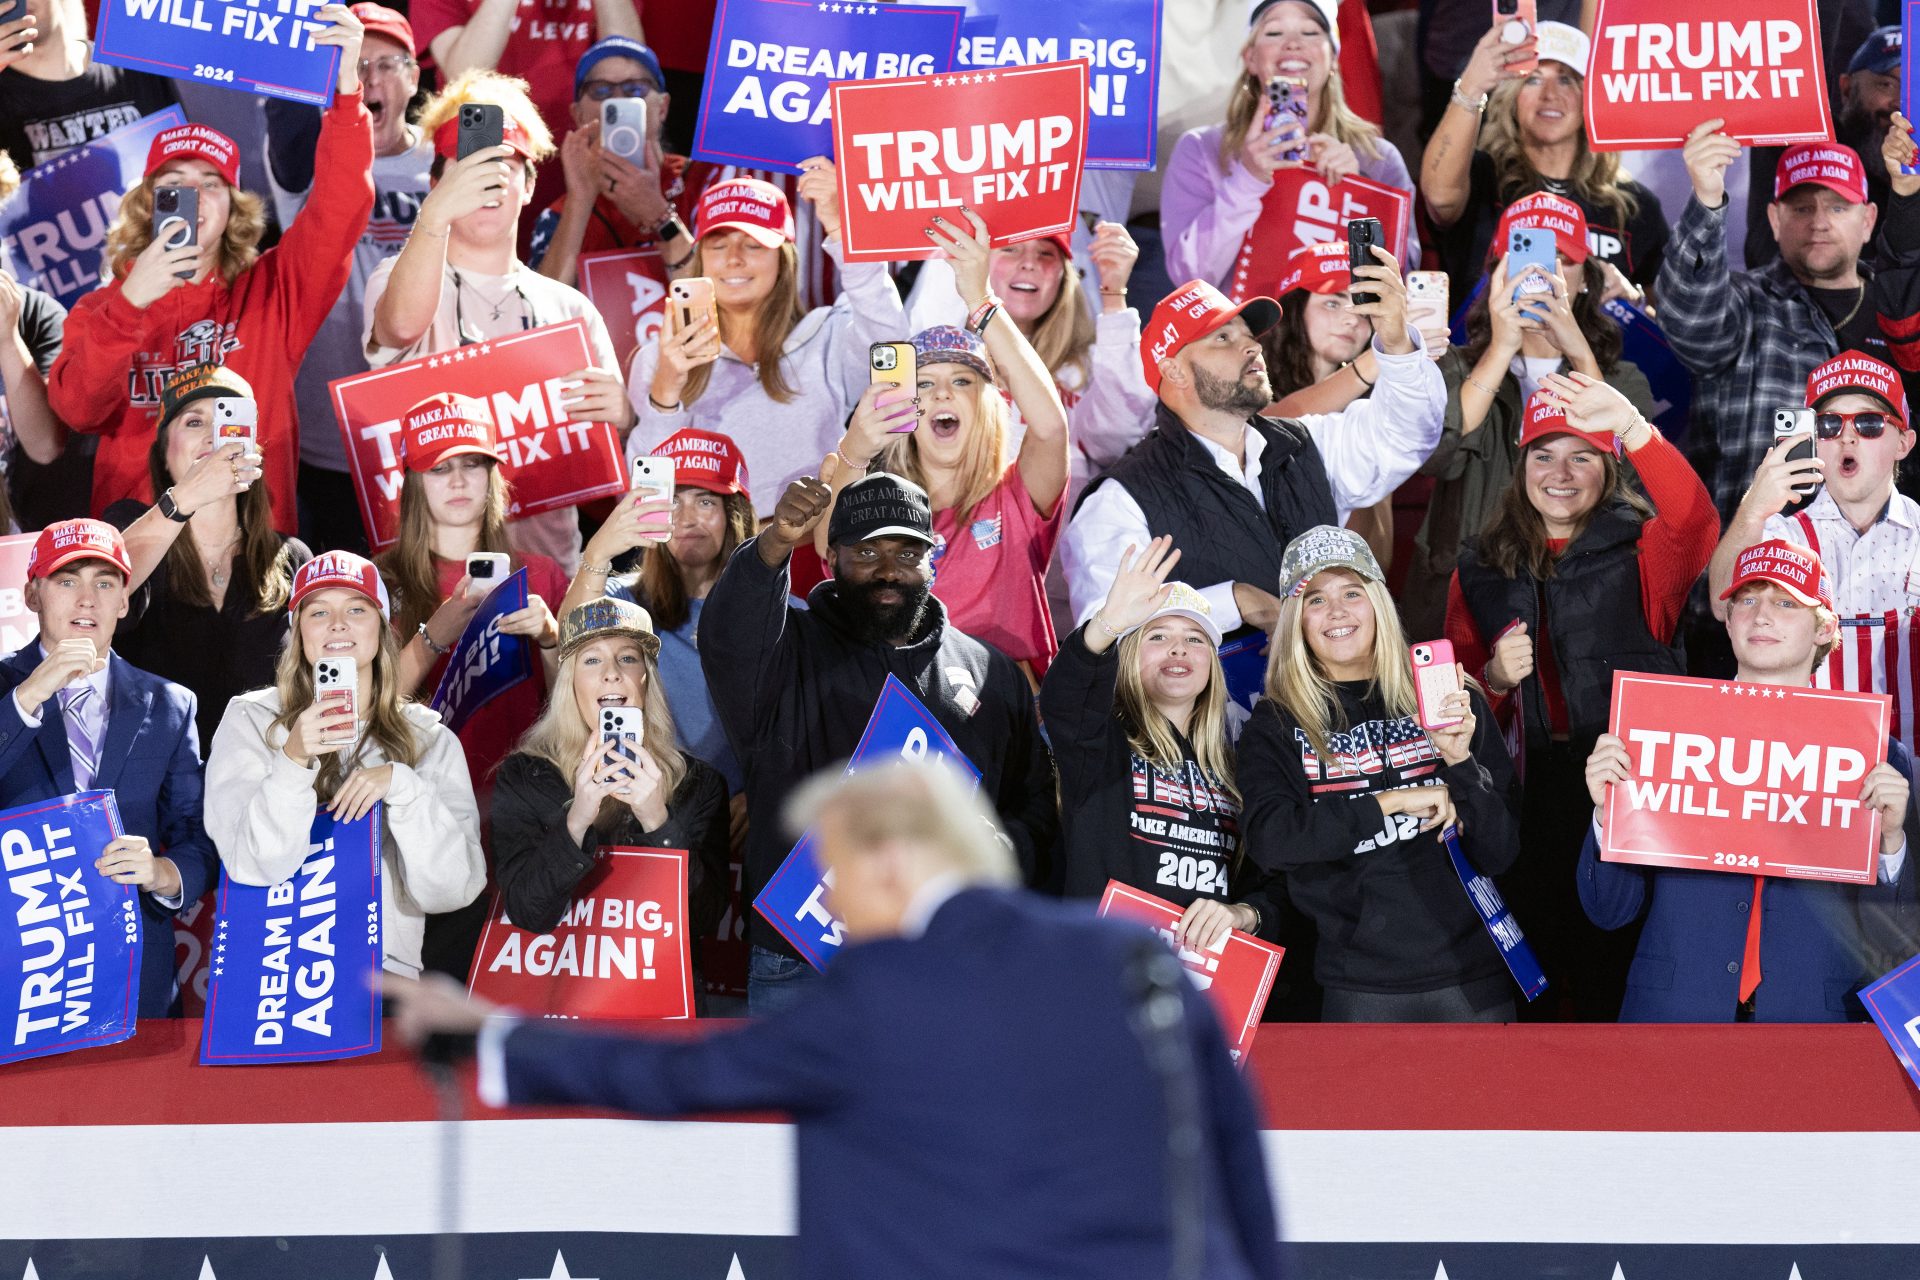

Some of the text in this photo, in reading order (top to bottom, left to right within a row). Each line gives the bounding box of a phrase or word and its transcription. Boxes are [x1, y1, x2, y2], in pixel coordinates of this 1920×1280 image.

[124, 0, 213, 32] WILL
[222, 6, 283, 45] FIX
[289, 19, 328, 52] IT
[1070, 38, 1147, 75] BIG,
[1604, 19, 1803, 71] TRUMP
[727, 39, 867, 80] DREAM
[193, 64, 234, 83] 2024
[1602, 69, 1804, 104] WILL FIX IT
[160, 126, 233, 156] MAKE AMERICA
[163, 140, 228, 165] GREAT AGAIN
[852, 115, 1073, 179] TRUMP
[1785, 150, 1854, 171] MAKE AMERICA
[1790, 165, 1850, 184] GREAT AGAIN
[704, 185, 777, 207] MAKE AMERICA
[858, 163, 1069, 212] WILL FIX IT
[706, 201, 771, 221] GREAT AGAIN
[1506, 197, 1579, 221] MAKE AMERICA
[1542, 215, 1575, 236] AGAIN
[1312, 244, 1345, 257] MAKE
[1320, 260, 1350, 274] GREA
[1151, 322, 1180, 364] 45-47
[168, 367, 200, 388] MAKE
[1812, 358, 1895, 384] MAKE AMERICA
[1816, 373, 1889, 395] GREAT AGAIN
[409, 408, 442, 431] MAKE
[418, 424, 454, 446] GREAT
[555, 422, 593, 455] IT
[674, 438, 728, 457] AMERICA
[683, 456, 721, 472] AGAIN
[842, 488, 875, 509] MAKE
[850, 506, 923, 525] GREAT AGAIN
[52, 525, 76, 540] MAKE
[55, 534, 83, 549] GREAT
[306, 554, 364, 581] MAGA
[1299, 545, 1355, 565] TRUMP
[1739, 546, 1813, 574] MAKE AMERICA
[1740, 561, 1807, 585] GREAT AGAIN
[1628, 728, 1866, 794] TRUMP
[1627, 780, 1860, 829] WILL FIX IT
[1168, 823, 1225, 847] AMERICA
[1713, 852, 1760, 869] 2024
[1156, 852, 1228, 896] 2024
[42, 823, 94, 1034] WILL FIX IT
[122, 900, 138, 944] 2024
[368, 901, 379, 946] 2024
[602, 898, 674, 938] BIG,
[0, 828, 66, 1045] TRUMP
[488, 932, 656, 980] AGAIN!
[254, 916, 293, 1045] DREAM
